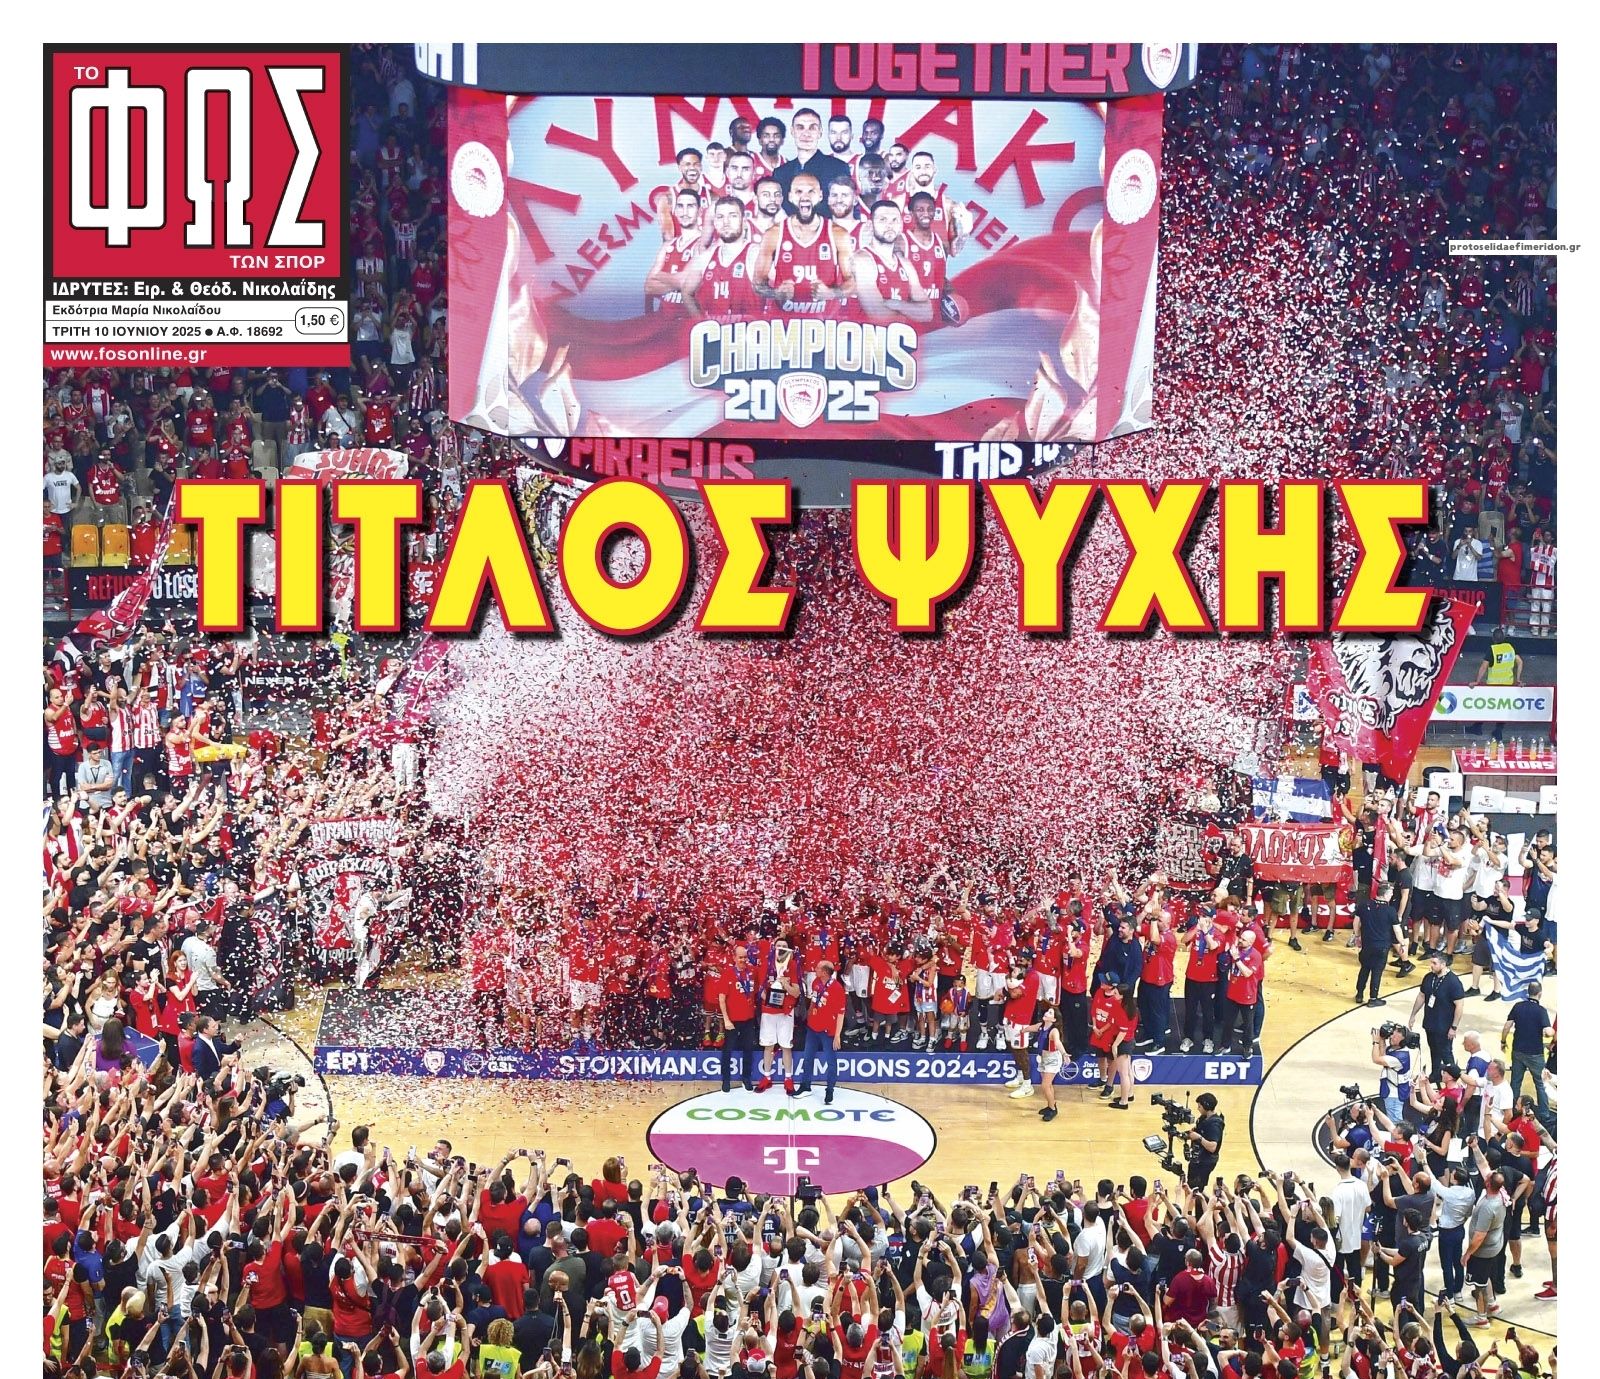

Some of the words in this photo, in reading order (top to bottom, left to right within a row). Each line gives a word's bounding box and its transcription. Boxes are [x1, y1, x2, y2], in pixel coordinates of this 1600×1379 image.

[74, 66, 100, 80] ΤΟ
[801, 43, 1132, 94] TOGETHER
[69, 66, 326, 248] ΦΩΣ
[230, 255, 269, 269] ΤΩΝ
[274, 255, 326, 269] ΣΠΟΡ
[53, 281, 129, 296] ΙΔΡΥΤΕΣ:
[134, 281, 166, 298] Ειρ.
[171, 282, 184, 296] &
[189, 280, 237, 296] Θεόδ.
[242, 280, 336, 300] Νικολαΐδης
[52, 305, 109, 318] Εκδότρια
[111, 305, 149, 318] Μαρία
[153, 304, 221, 316] Νικολαΐδου
[300, 314, 326, 328] 1,50
[329, 314, 340, 326] €
[52, 326, 90, 337] ΤΡΙΤΗ
[94, 326, 109, 337] 10
[112, 326, 168, 337] ΙΟΥΝΙΟΥ
[172, 326, 201, 337] 2025
[216, 326, 242, 337] Α.Φ.
[247, 326, 283, 337] 18692
[50, 346, 208, 363] www.fosonline.gr
[690, 319, 917, 390] CHAMPIONS
[724, 379, 776, 421] 20
[829, 380, 880, 422] 25
[175, 479, 797, 632] ΤΙΤΛΟΣ
[851, 479, 1437, 632] ΨΥΧΗΣ
[1470, 759, 1555, 770] VSITORS
[559, 1055, 696, 1076] STOIXIMAN
[914, 1057, 1018, 1080] 2024-25
[1204, 1061, 1251, 1080] ΕΡΤ
